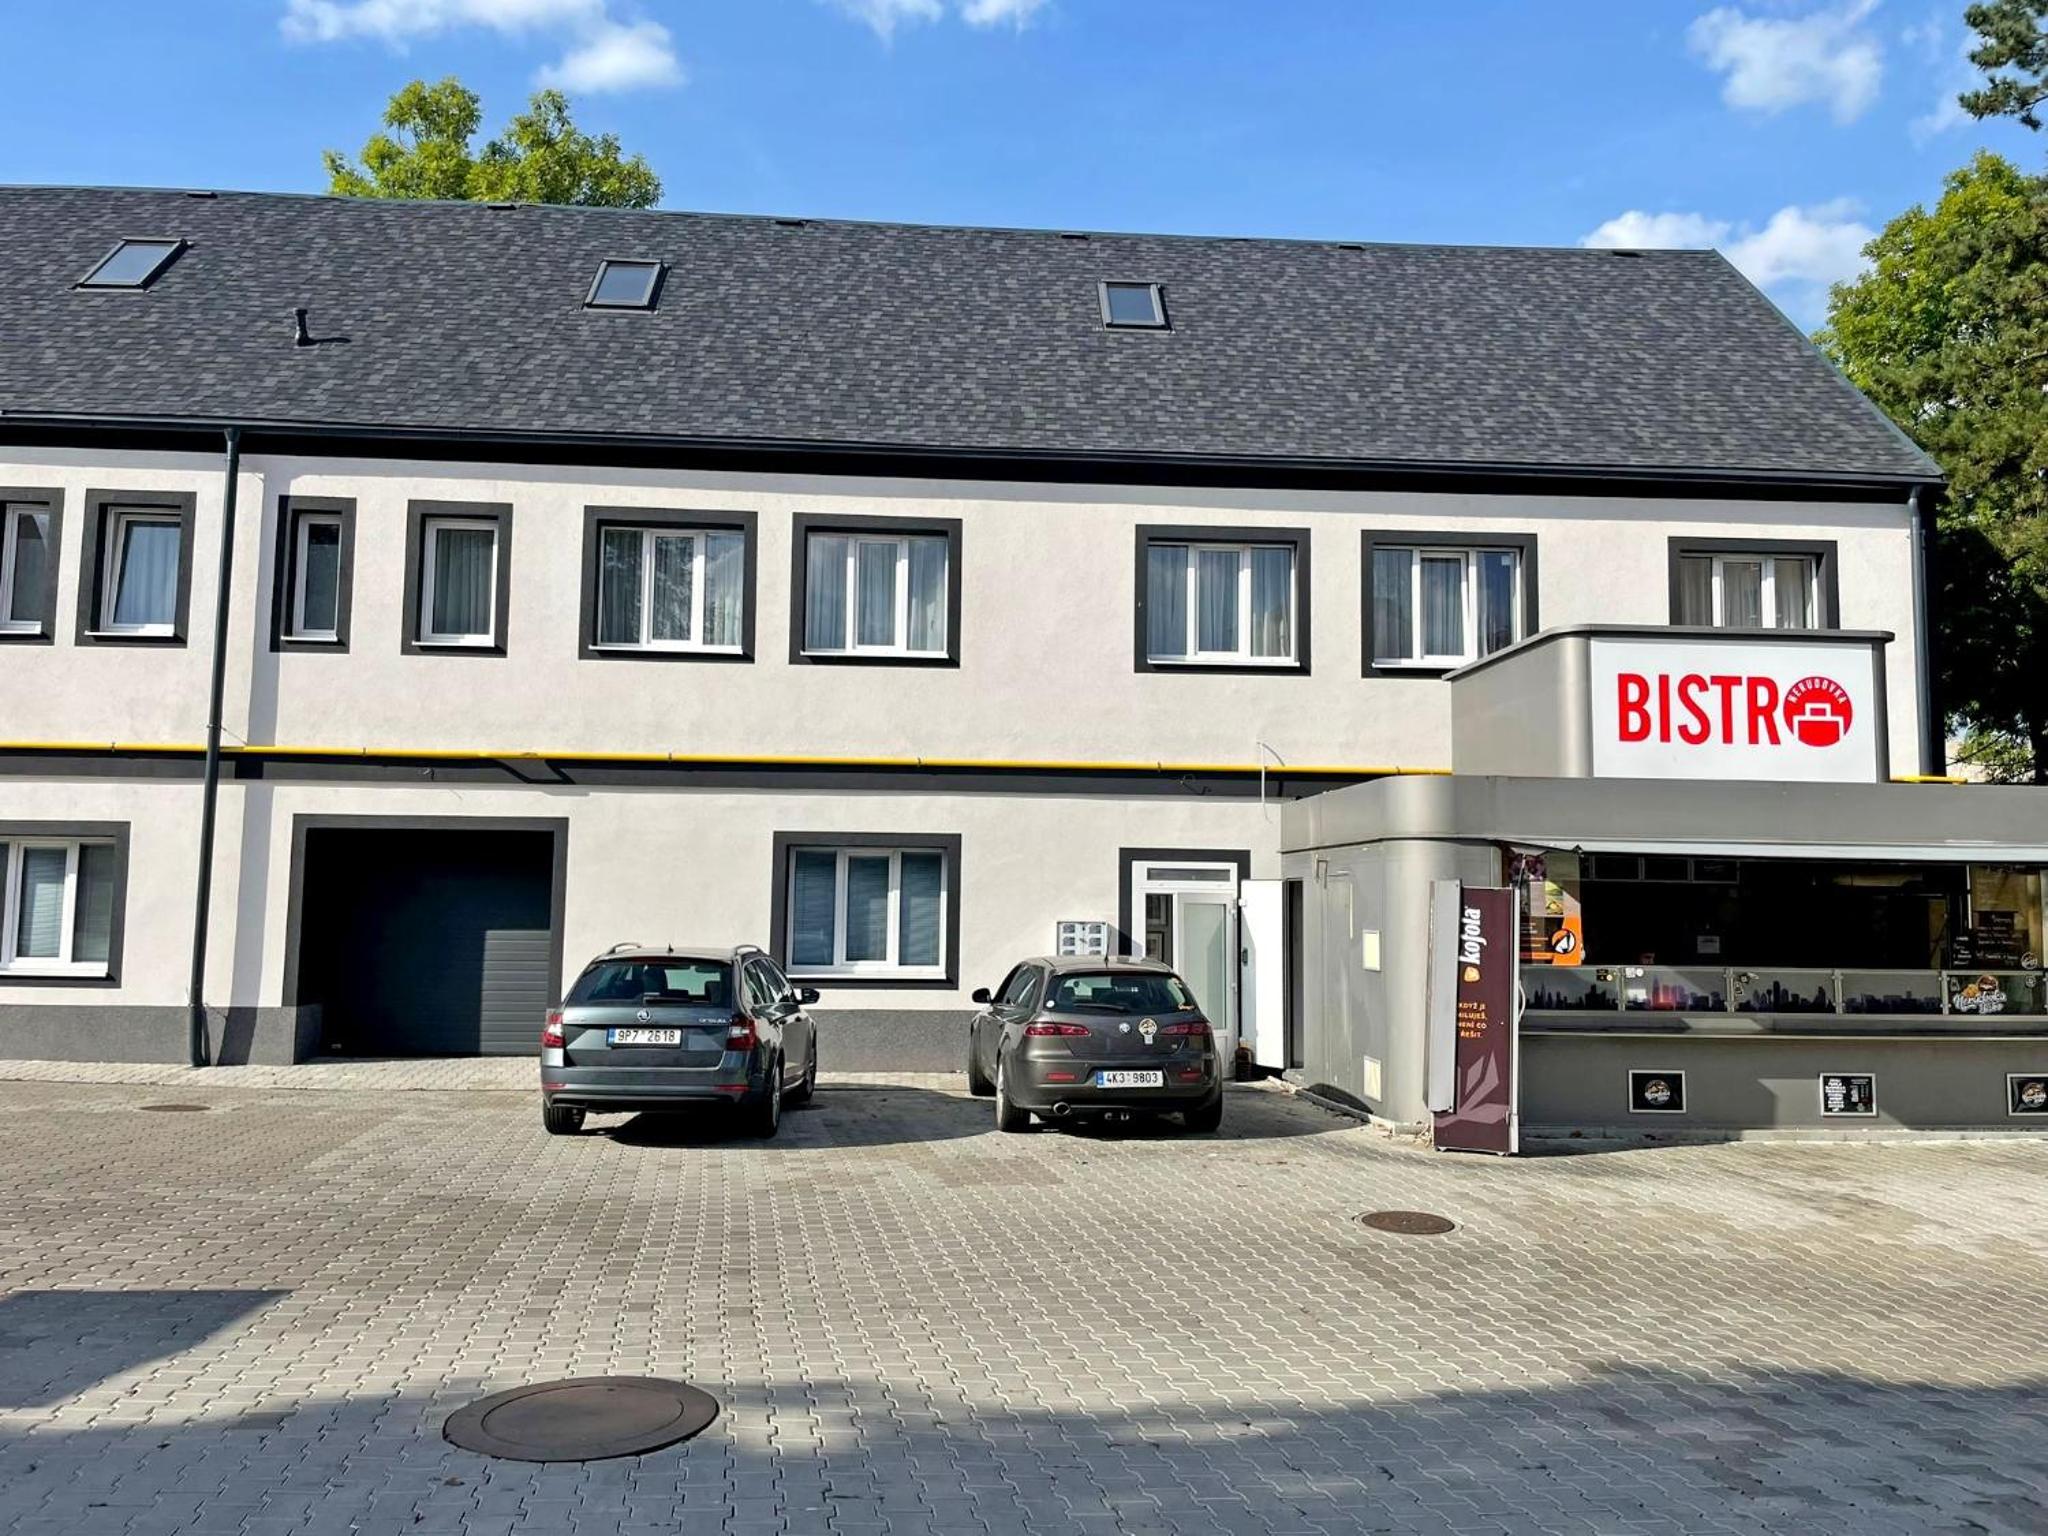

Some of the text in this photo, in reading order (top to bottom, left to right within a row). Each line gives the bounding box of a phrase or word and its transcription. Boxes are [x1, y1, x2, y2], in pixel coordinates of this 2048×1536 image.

[1459, 909, 1487, 965] kofola
[618, 1030, 676, 1042] 9P7 2618
[1106, 1072, 1158, 1084] 4K3 9803
